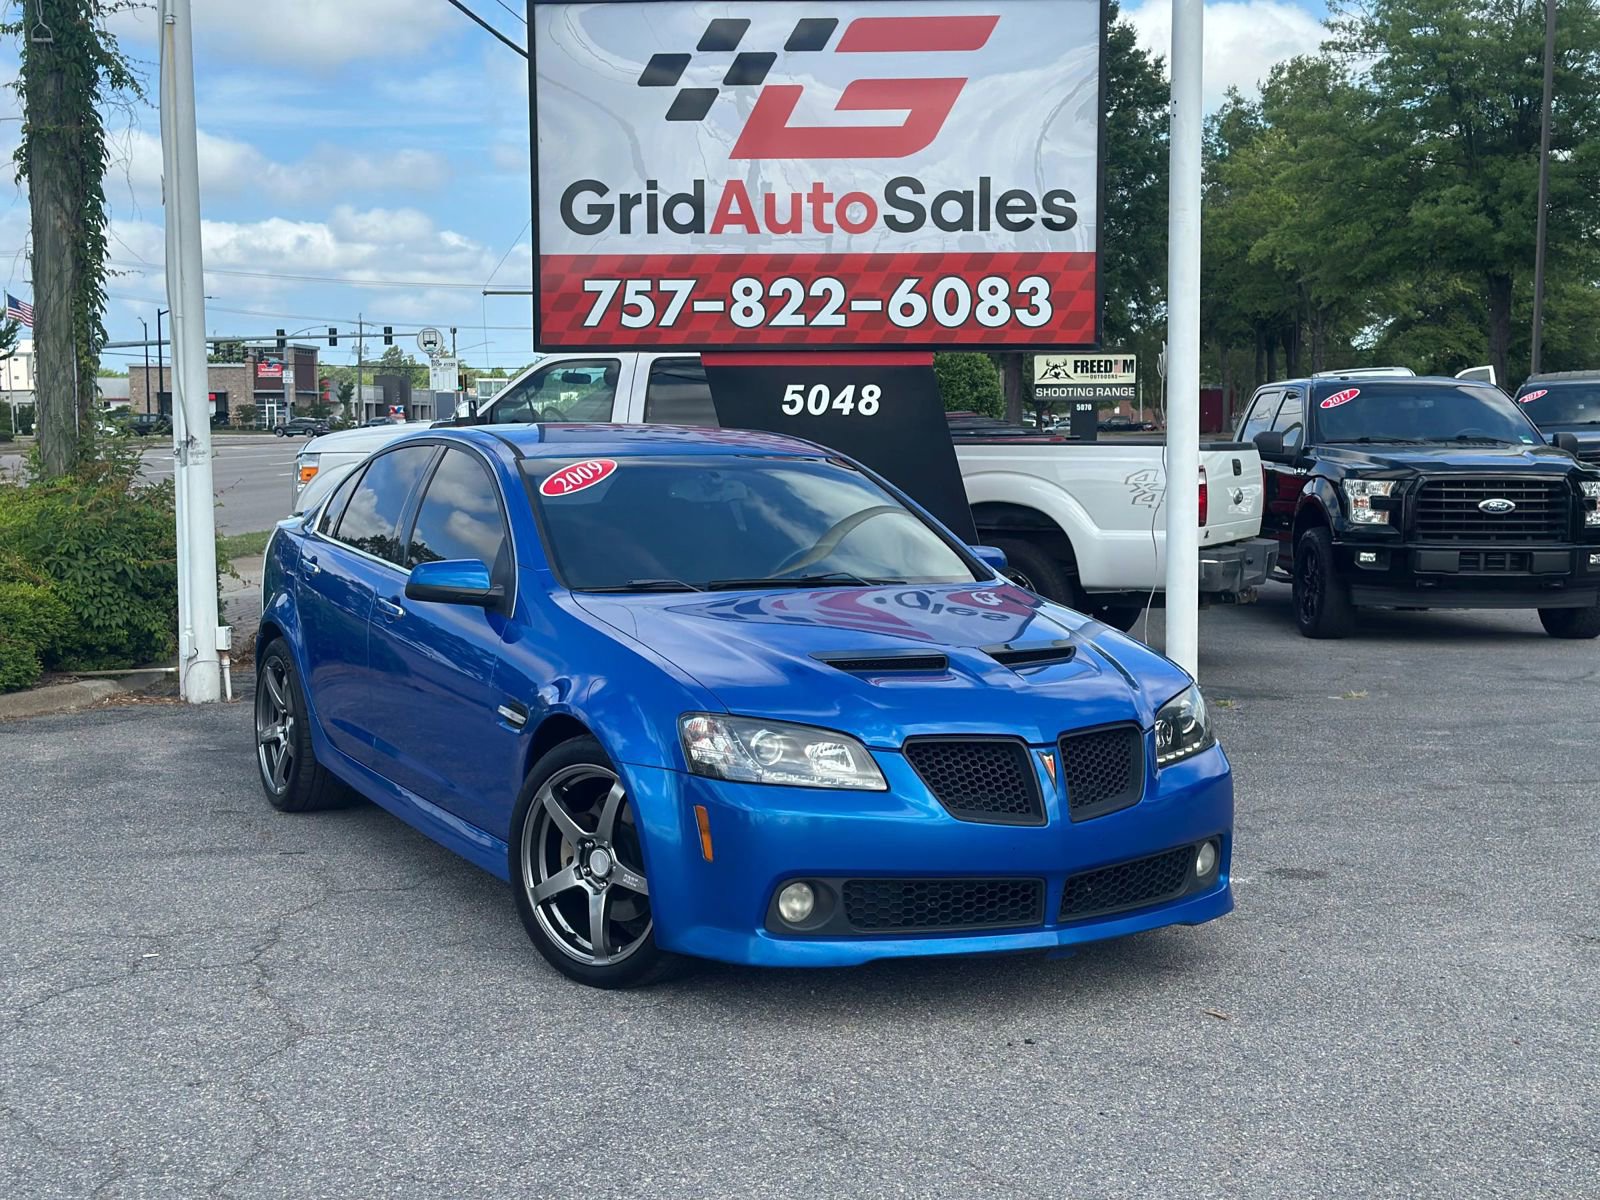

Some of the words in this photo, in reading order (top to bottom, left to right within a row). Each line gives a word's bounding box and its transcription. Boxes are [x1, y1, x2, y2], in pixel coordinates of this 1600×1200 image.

[582, 275, 1054, 330] 757-822-6083
[1073, 359, 1135, 373] FREEDM
[781, 384, 881, 416] 5048
[1035, 387, 1094, 397] SHOOTING
[1096, 387, 1136, 396] RANGE
[1326, 390, 1351, 406] 2017
[1076, 403, 1092, 411] 5070
[554, 461, 603, 492] 2009
